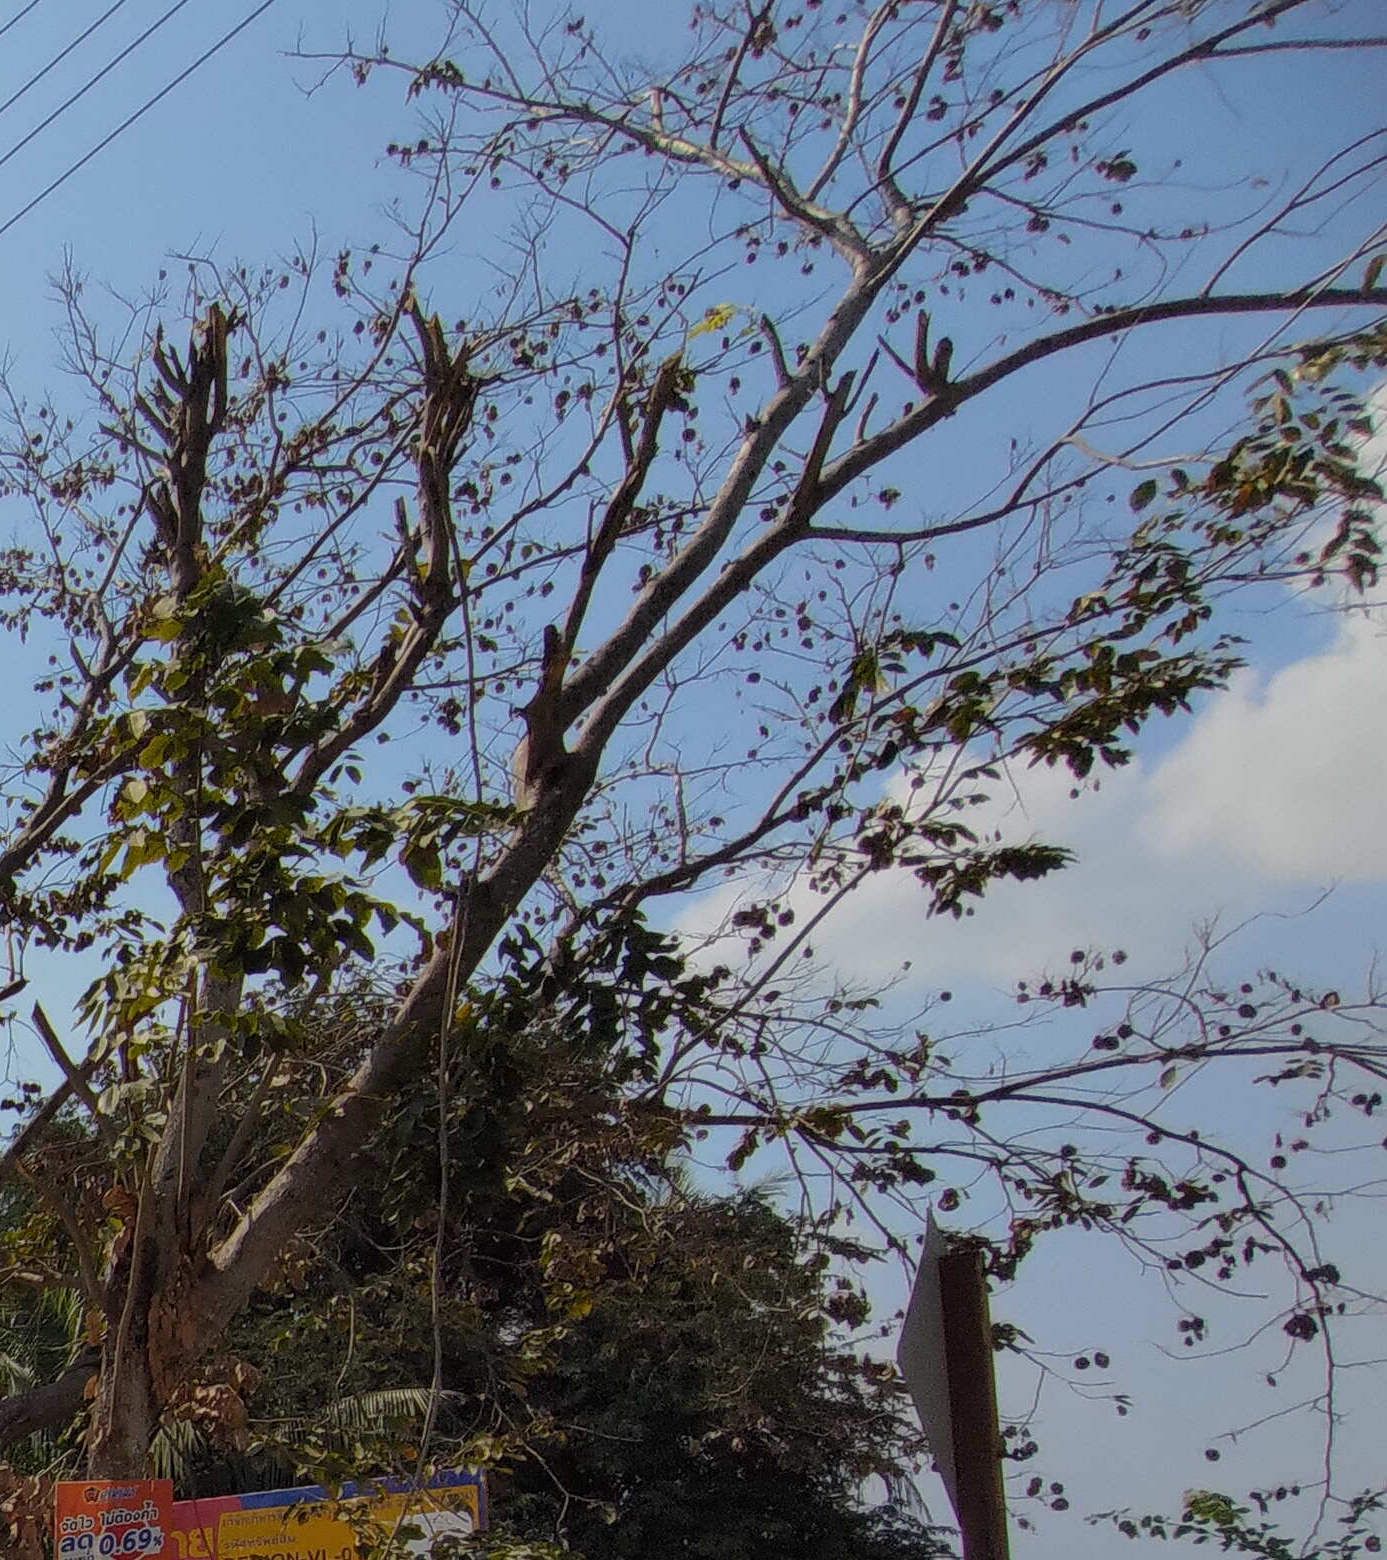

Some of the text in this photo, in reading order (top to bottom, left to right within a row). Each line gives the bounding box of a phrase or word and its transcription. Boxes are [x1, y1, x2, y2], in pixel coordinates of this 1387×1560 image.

[60, 1528, 163, 1556] ลด 0.69%
[170, 1527, 214, 1559] าย
